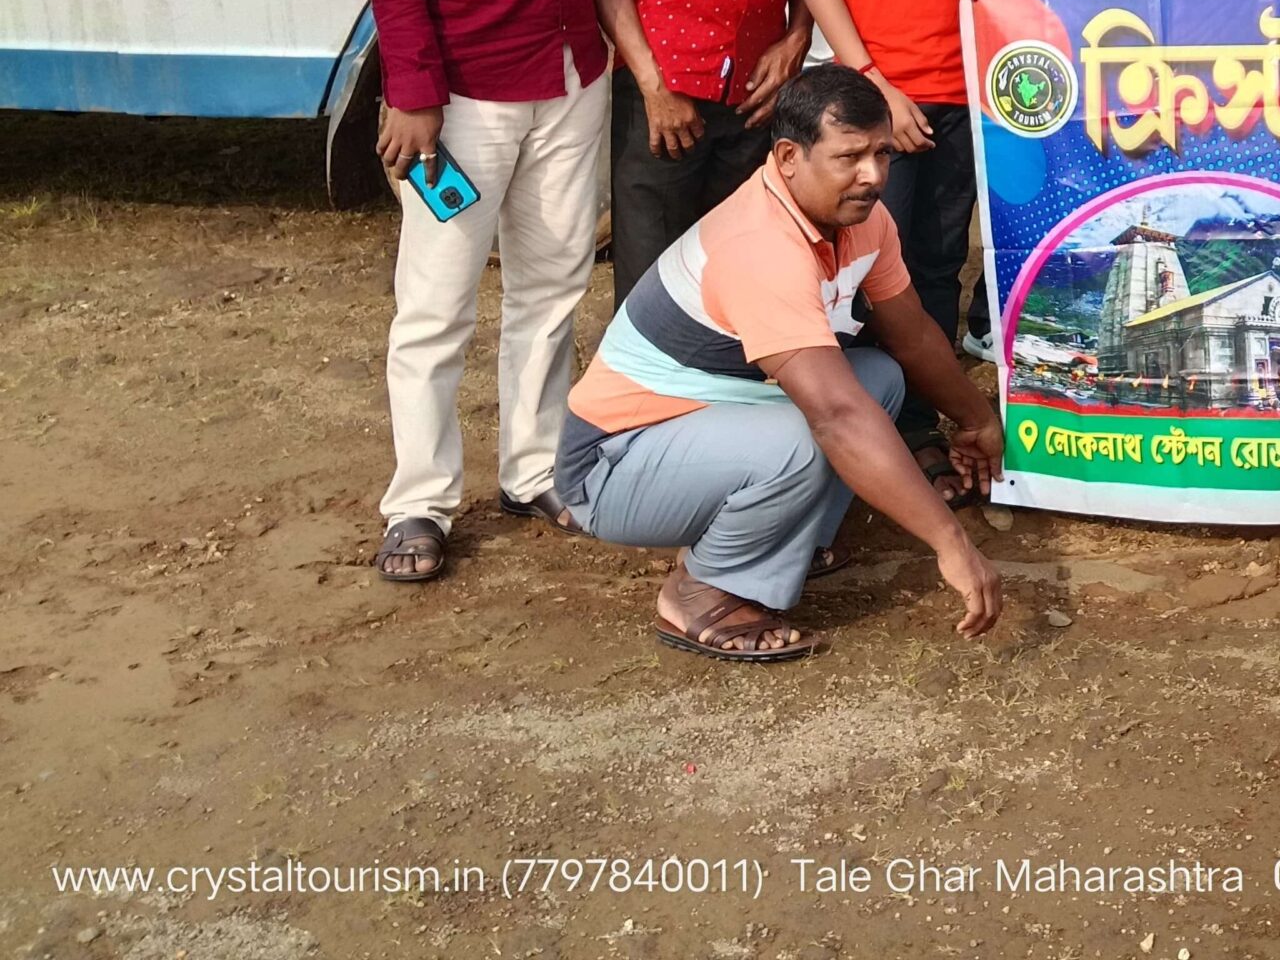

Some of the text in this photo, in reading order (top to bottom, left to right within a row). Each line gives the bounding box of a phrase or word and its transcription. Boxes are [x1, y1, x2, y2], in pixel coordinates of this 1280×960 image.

[1007, 54, 1050, 70] CRYSTAL
[1013, 110, 1052, 126] TOURISM
[1045, 425, 1143, 464] লোকনাথ
[1150, 426, 1223, 467] স্টেশন
